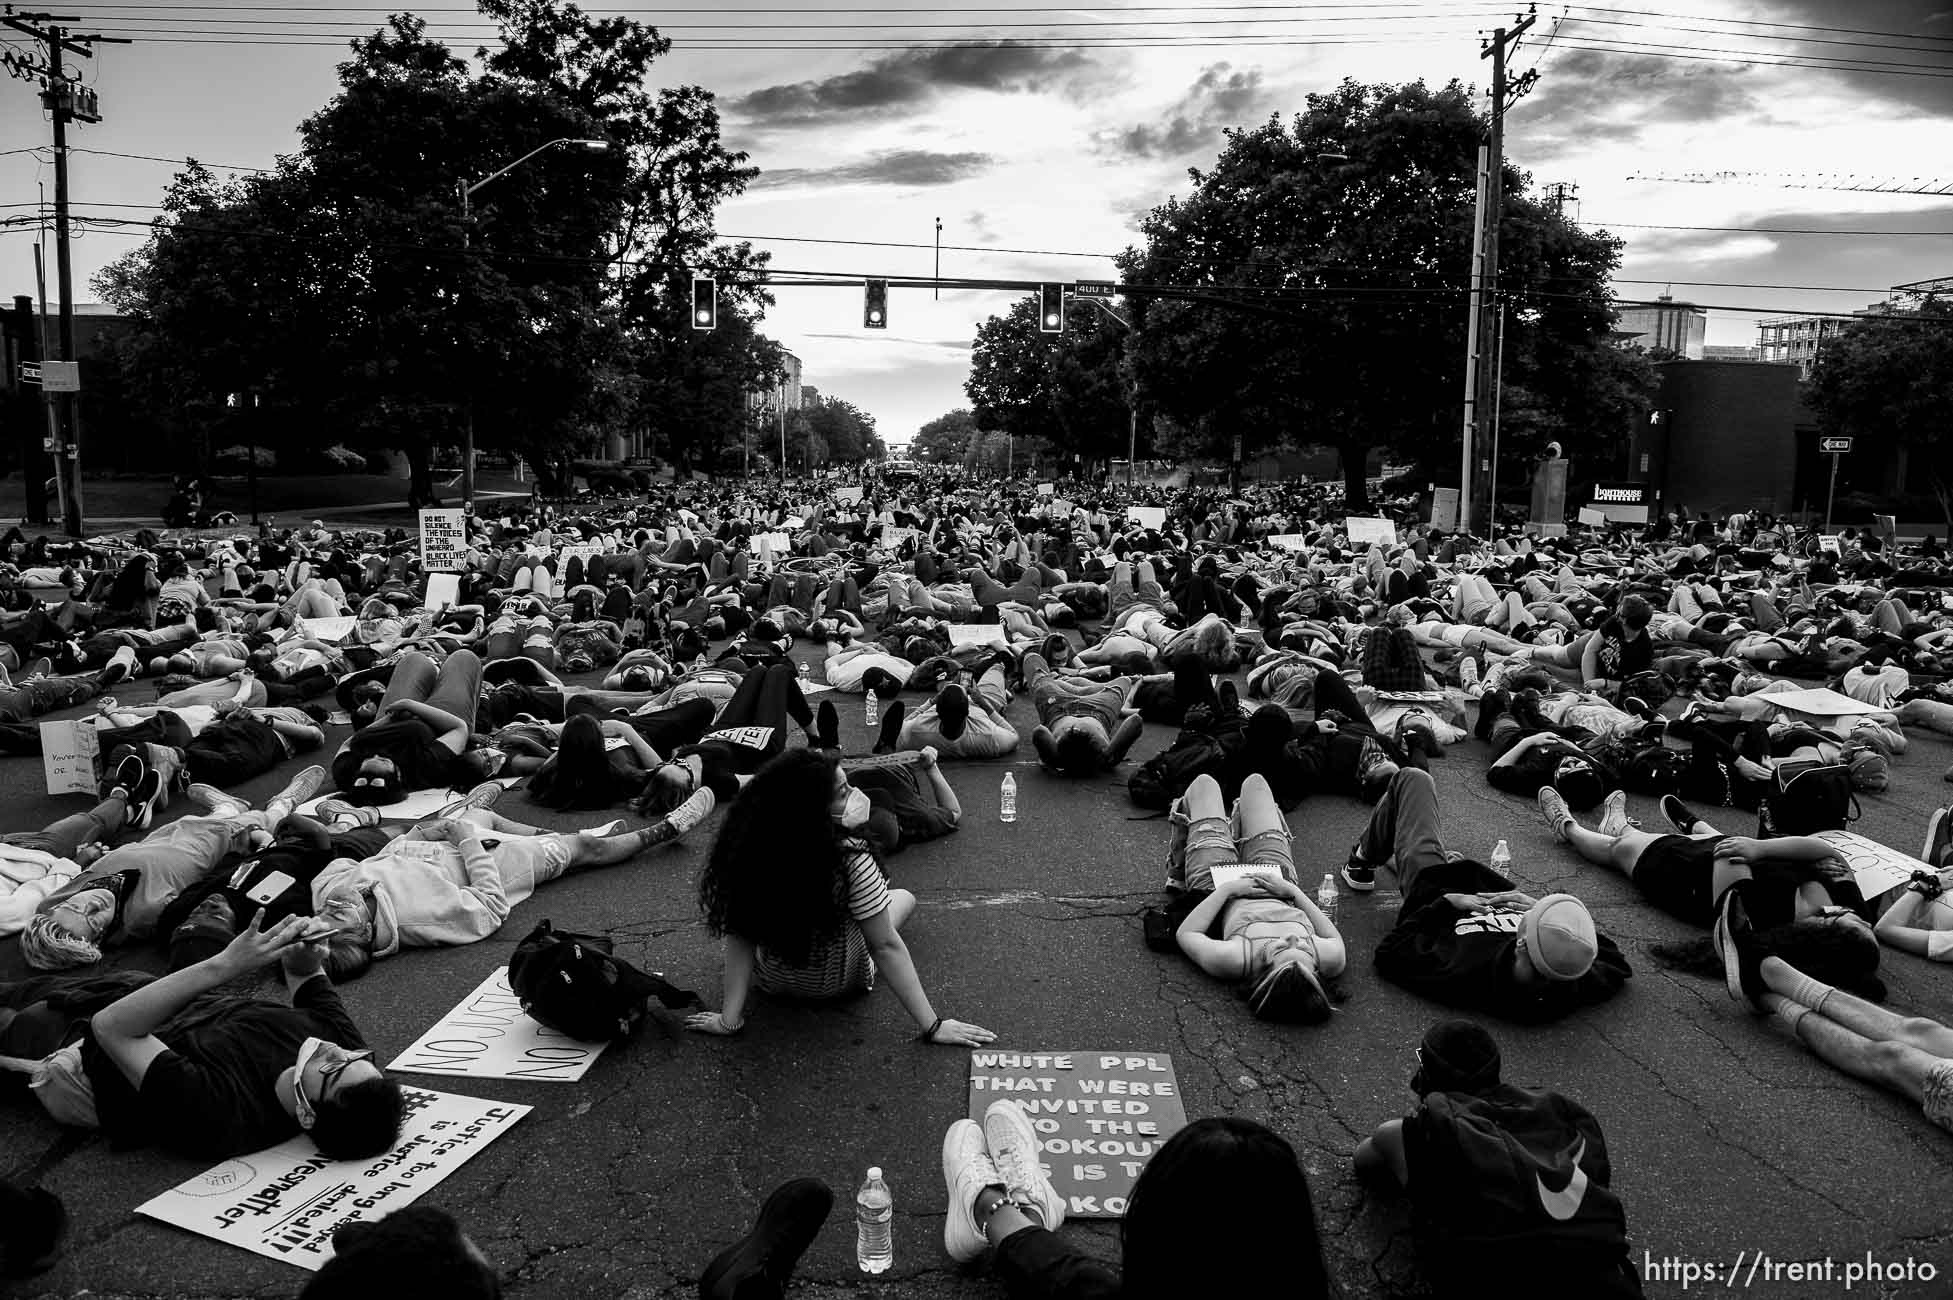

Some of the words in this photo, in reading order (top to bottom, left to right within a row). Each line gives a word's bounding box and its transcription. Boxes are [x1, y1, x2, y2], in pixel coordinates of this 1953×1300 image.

[1079, 285, 1099, 293] 400
[1103, 286, 1112, 294] E
[425, 529, 439, 537] THE
[439, 529, 463, 537] VOICES
[435, 537, 449, 545] THE
[425, 552, 448, 561] BLACK
[404, 1039, 489, 1072] NO
[447, 973, 526, 1039] JUSTI
[505, 1047, 590, 1079] NO
[972, 1053, 1073, 1070] WHITE
[1100, 1055, 1167, 1072] PPL
[970, 1075, 1057, 1092] THAT
[1078, 1079, 1174, 1097] WERE
[1015, 1099, 1150, 1115] NVITED
[430, 1120, 458, 1131] is
[431, 1107, 515, 1156] Justice
[1031, 1118, 1060, 1134] O
[1085, 1118, 1159, 1136] THE
[1038, 1138, 1166, 1157] OKOU
[401, 1161, 438, 1179] too
[1073, 1164, 1107, 1181] IS
[352, 1181, 412, 1209] long
